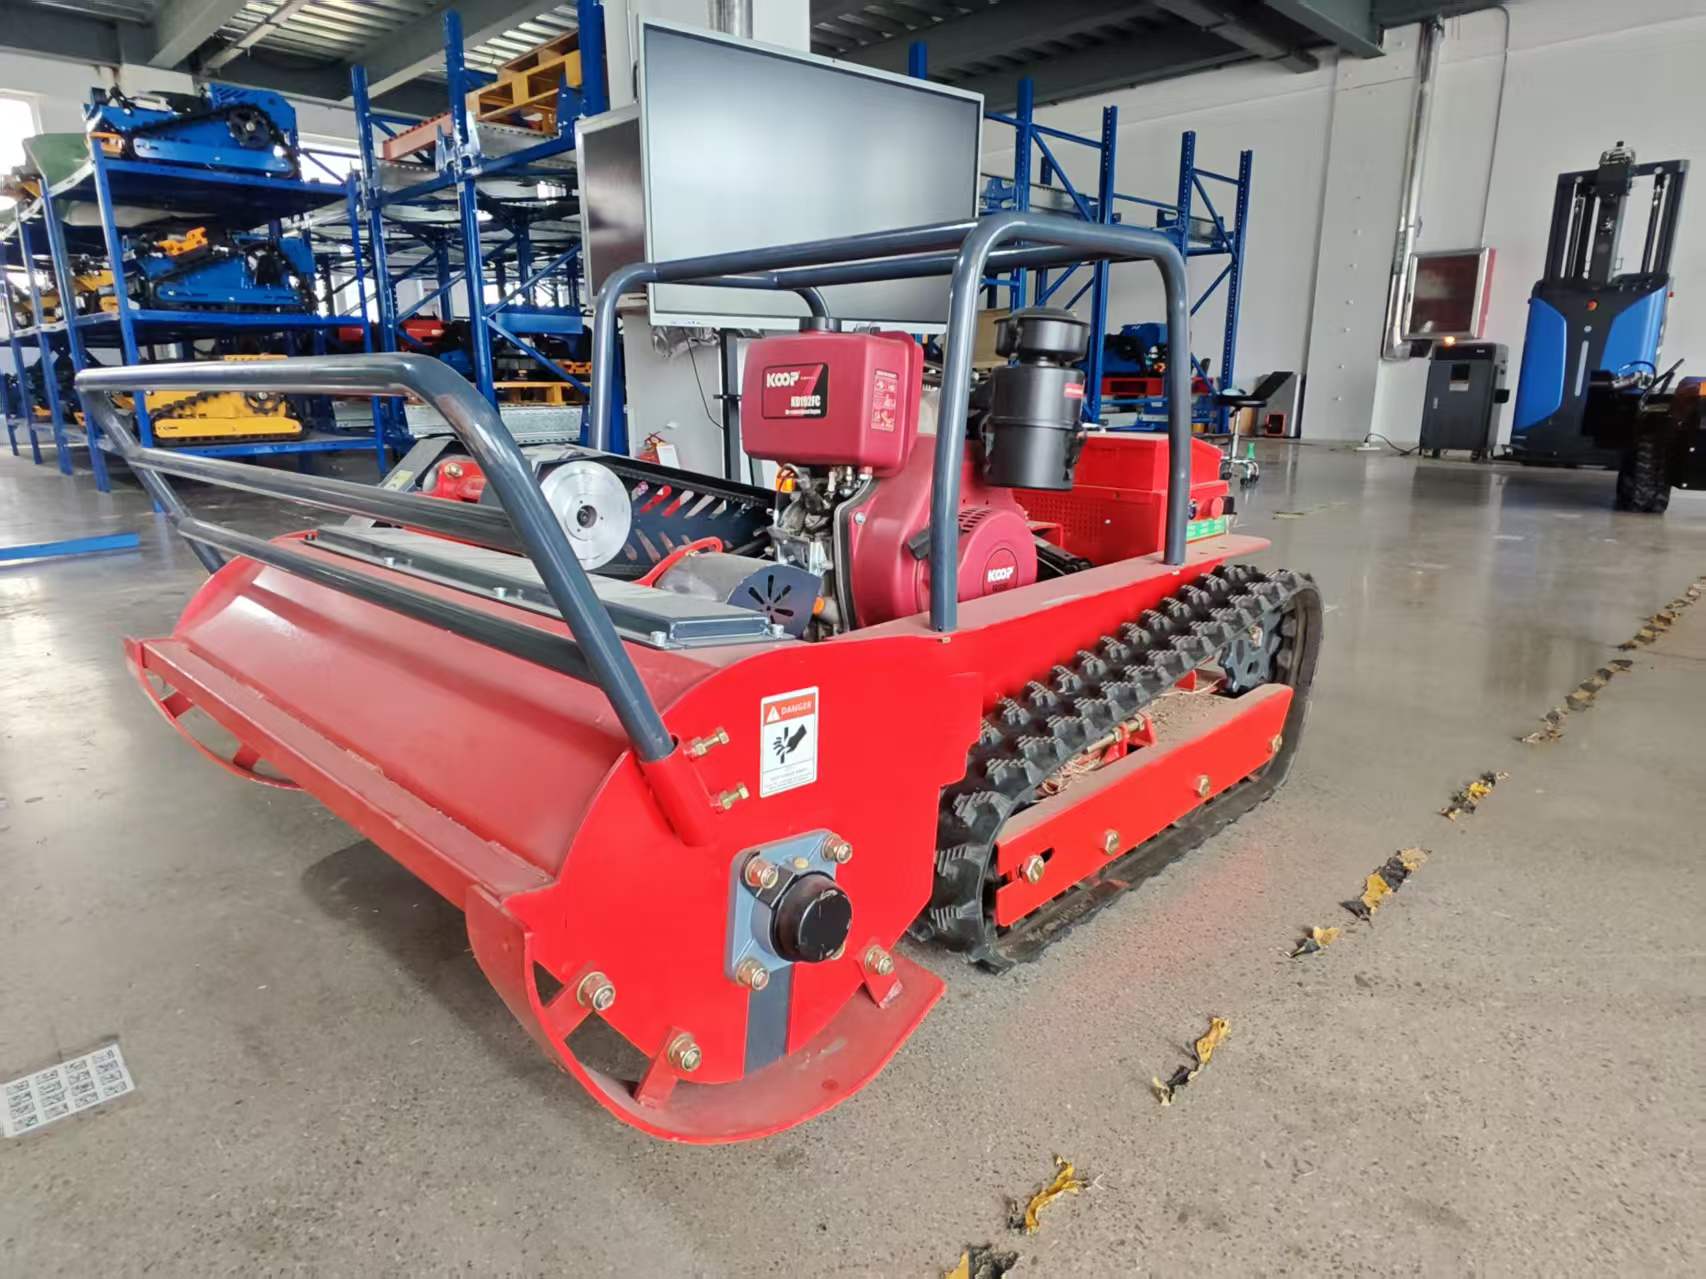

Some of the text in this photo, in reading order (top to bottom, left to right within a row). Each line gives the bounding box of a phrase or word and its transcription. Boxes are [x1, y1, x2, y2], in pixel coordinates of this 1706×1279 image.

[766, 371, 801, 388] KOOP
[987, 566, 1015, 583] KOOP
[781, 701, 813, 716] DANGER
